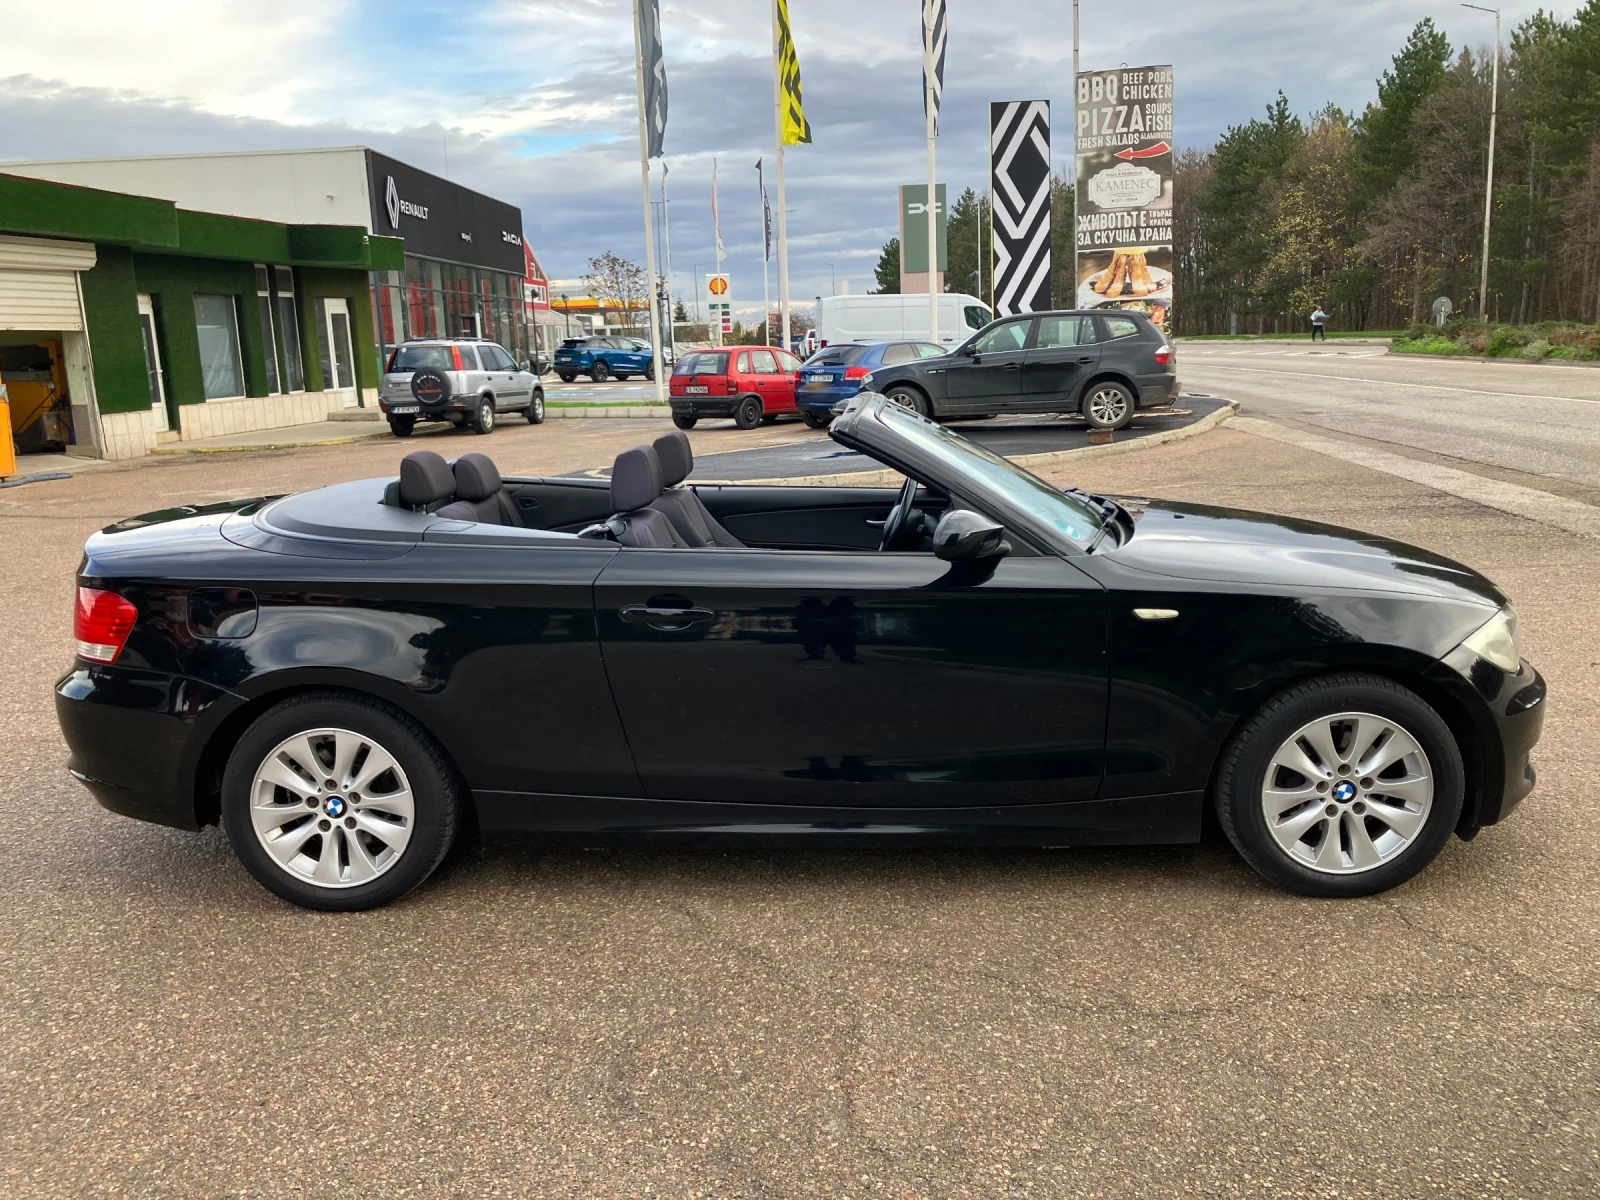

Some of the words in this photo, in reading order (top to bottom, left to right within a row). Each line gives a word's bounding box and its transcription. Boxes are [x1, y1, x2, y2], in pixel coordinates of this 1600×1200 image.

[1122, 72, 1144, 85] BEEF
[1148, 70, 1172, 83] PORK
[1077, 74, 1118, 104] BBQ
[1122, 84, 1172, 100] CHICKEN
[1145, 103, 1172, 114] SOUPS
[1077, 105, 1145, 137] PIZZA
[1145, 115, 1172, 131] FISH
[1077, 136, 1104, 150] FRESH
[1105, 133, 1140, 147] SALADS
[1096, 178, 1155, 192] KAMENEC
[400, 200, 429, 220] RENAULT
[1148, 209, 1173, 218] ТВЪРДЕ
[1078, 211, 1139, 231] ЖИВОТЪТ
[1149, 218, 1173, 227] КРАТЪК
[502, 230, 522, 246] DACIA
[1078, 231, 1092, 246] ЗА
[1094, 228, 1137, 244] СКУЧНА
[1139, 226, 1173, 242] ХРАНА
